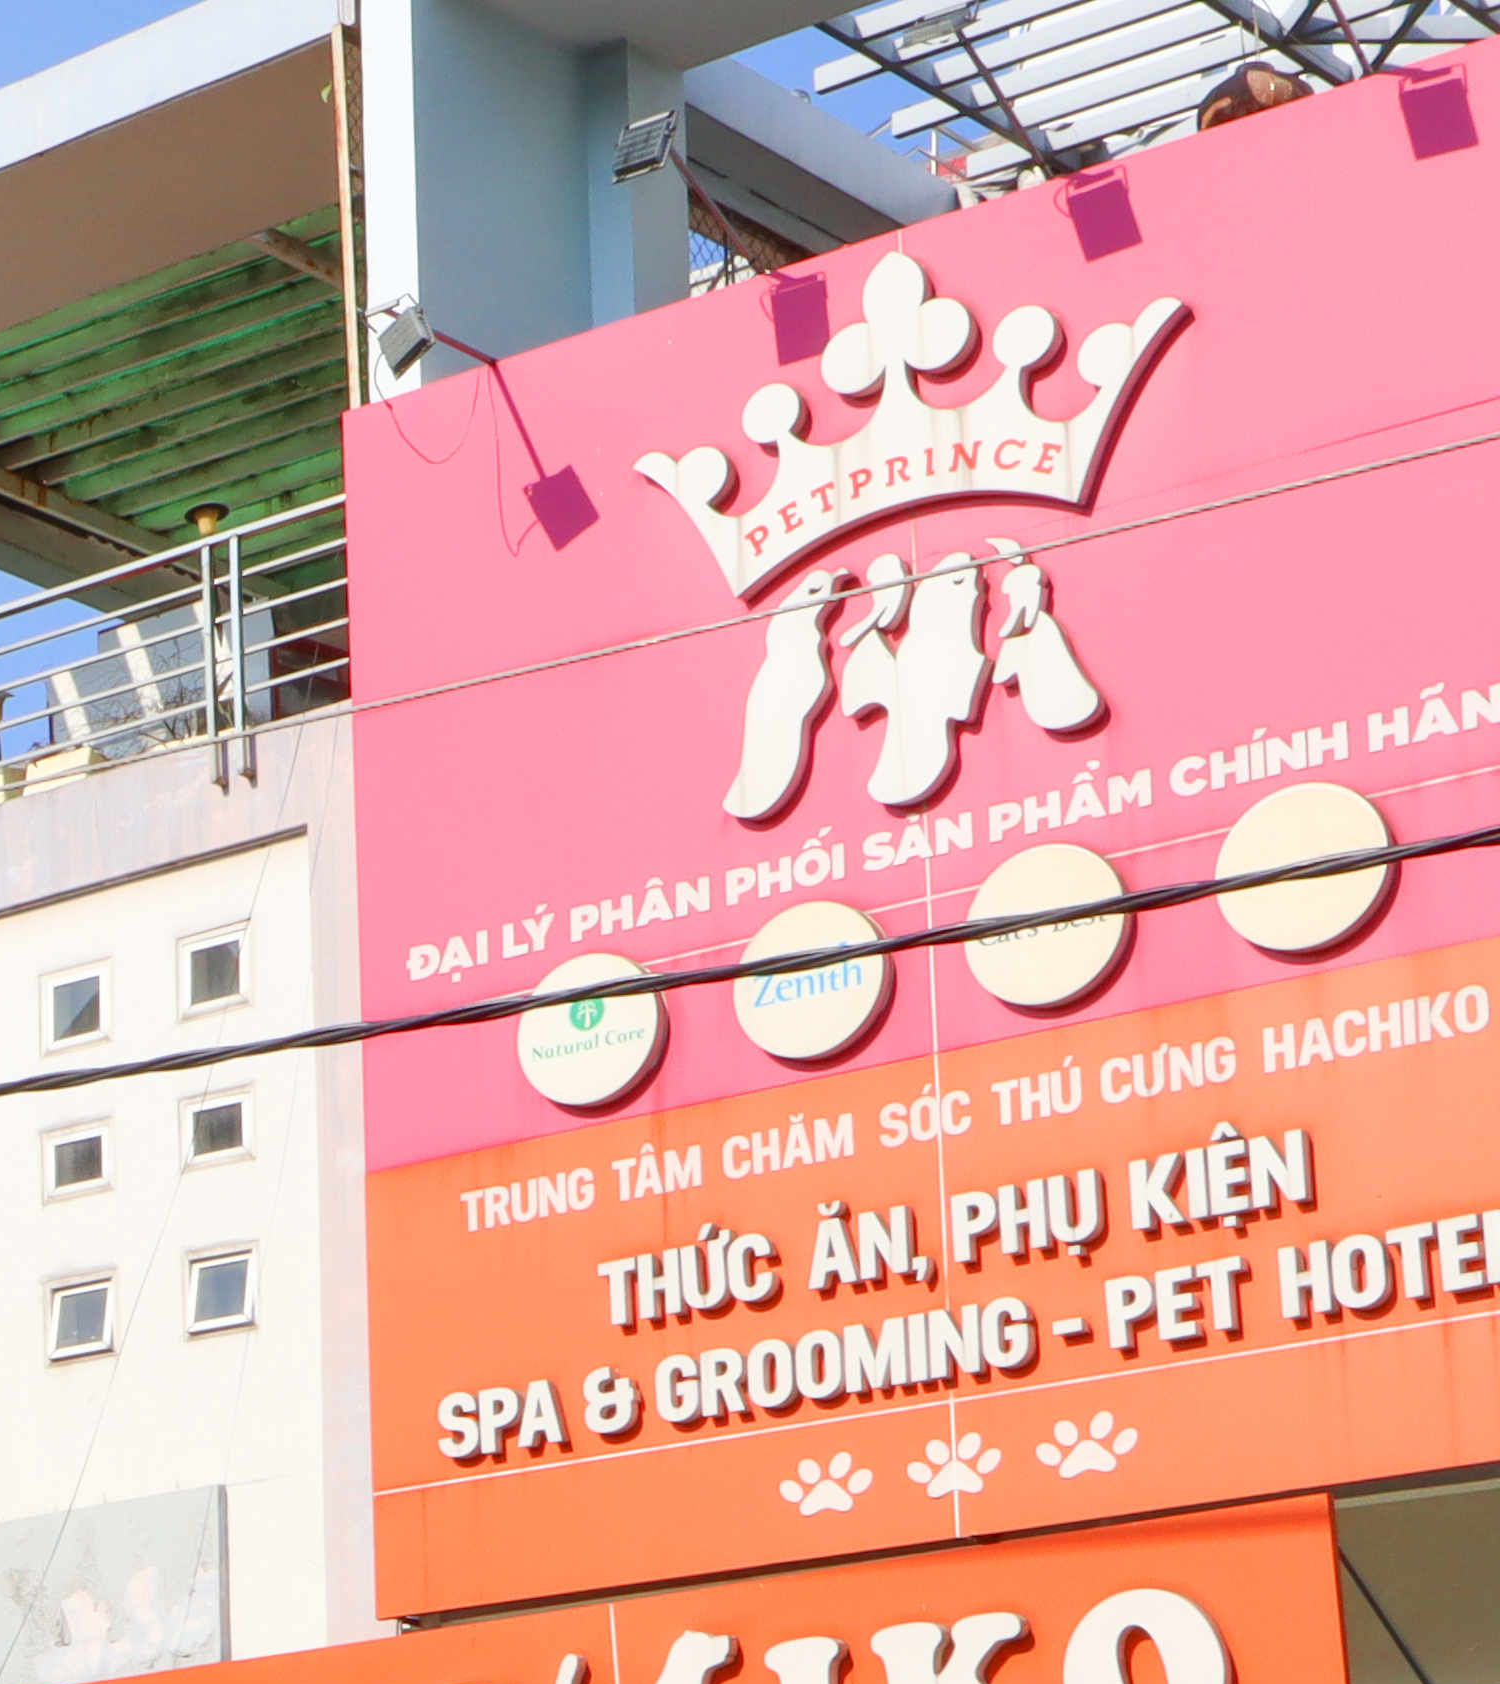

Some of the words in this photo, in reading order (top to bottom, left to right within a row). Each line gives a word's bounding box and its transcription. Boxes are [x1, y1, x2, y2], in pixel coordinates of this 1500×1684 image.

[743, 437, 1063, 558] PETPRINCE
[406, 931, 489, 982] ĐẠI
[502, 904, 556, 959] LÝ
[570, 876, 711, 943] PHÂN
[725, 826, 845, 906] PHỐI
[862, 811, 974, 872] SẢN
[988, 760, 1152, 843] PHẨM
[1170, 727, 1349, 797] CHÍNH
[459, 1166, 595, 1233] TRUNG
[611, 1137, 703, 1201] TÂM
[721, 1108, 855, 1180] CHĂM
[878, 1083, 972, 1142] SÓC
[995, 1055, 1083, 1120] THÚ
[1099, 1034, 1236, 1105] CƯNG
[1262, 983, 1490, 1072] HACHIKO
[531, 1033, 600, 1062] Natural
[605, 1027, 645, 1047] Core
[598, 1222, 773, 1328] THỨC
[809, 1203, 928, 1292] ĂN,
[951, 1167, 1099, 1267] PHỤ
[1128, 1123, 1312, 1231] KIỆN
[438, 1376, 560, 1461] SPA
[584, 1365, 639, 1435] &
[654, 1295, 1034, 1425] GROOMING
[1104, 1255, 1245, 1353] PET
